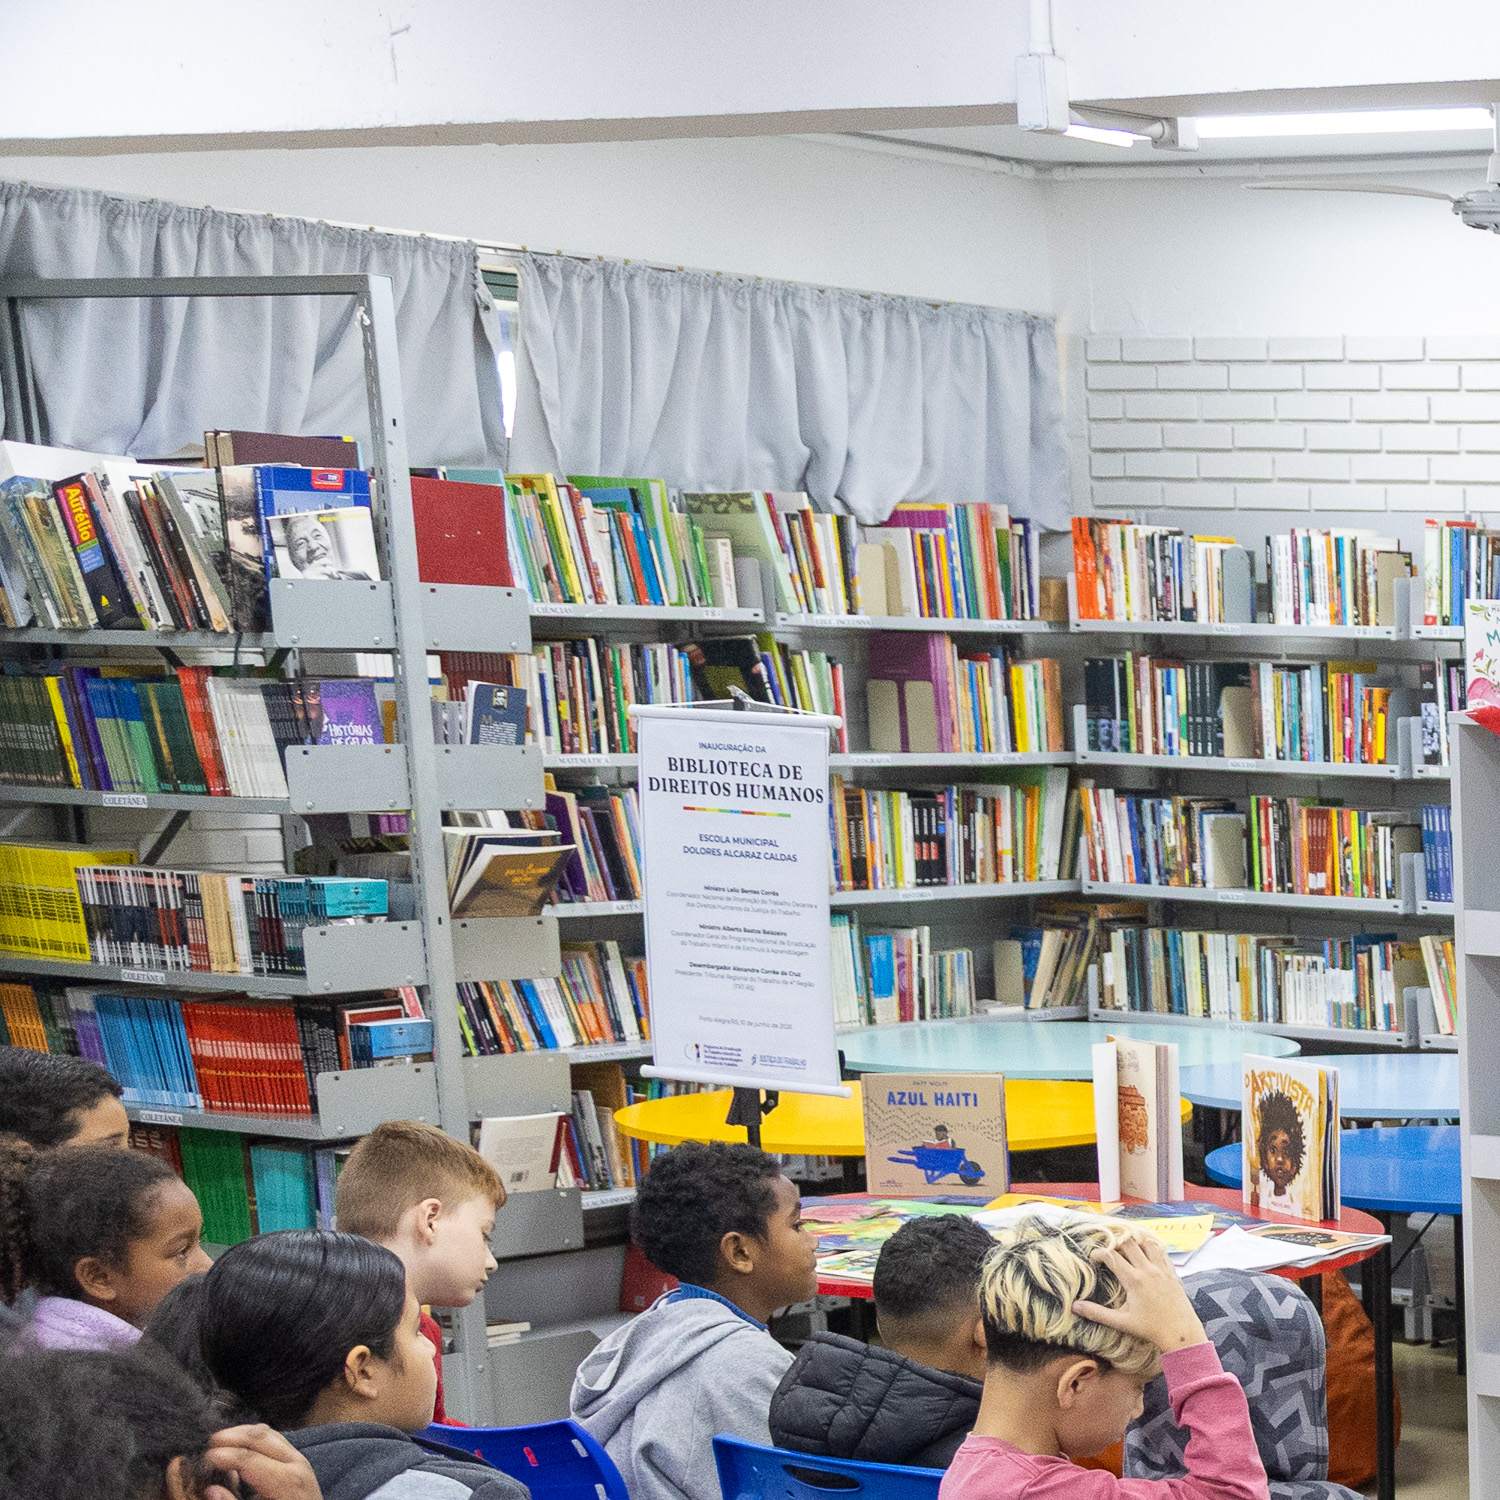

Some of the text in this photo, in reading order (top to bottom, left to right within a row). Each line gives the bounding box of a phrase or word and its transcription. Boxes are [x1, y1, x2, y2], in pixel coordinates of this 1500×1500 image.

[65, 487, 91, 542] Aurélio
[328, 721, 374, 737] HISTÓRIAS
[699, 742, 767, 753] INAUGURAÇÃO DA
[668, 757, 803, 781] BIBLIOTECA DE
[648, 776, 824, 804] DIREITOS HUMANOS
[103, 795, 148, 806] COLETÂNEA
[699, 834, 779, 848] ESCOLA MUNICIPAL
[683, 846, 798, 863] DOLORES ALCARAZ CALDAS
[122, 970, 166, 983] COLETÂNEA
[887, 1091, 978, 1107] AZUL HAITI
[1250, 1069, 1315, 1118] ARTIVISTA
[141, 1111, 183, 1124] COLETÂNEA
